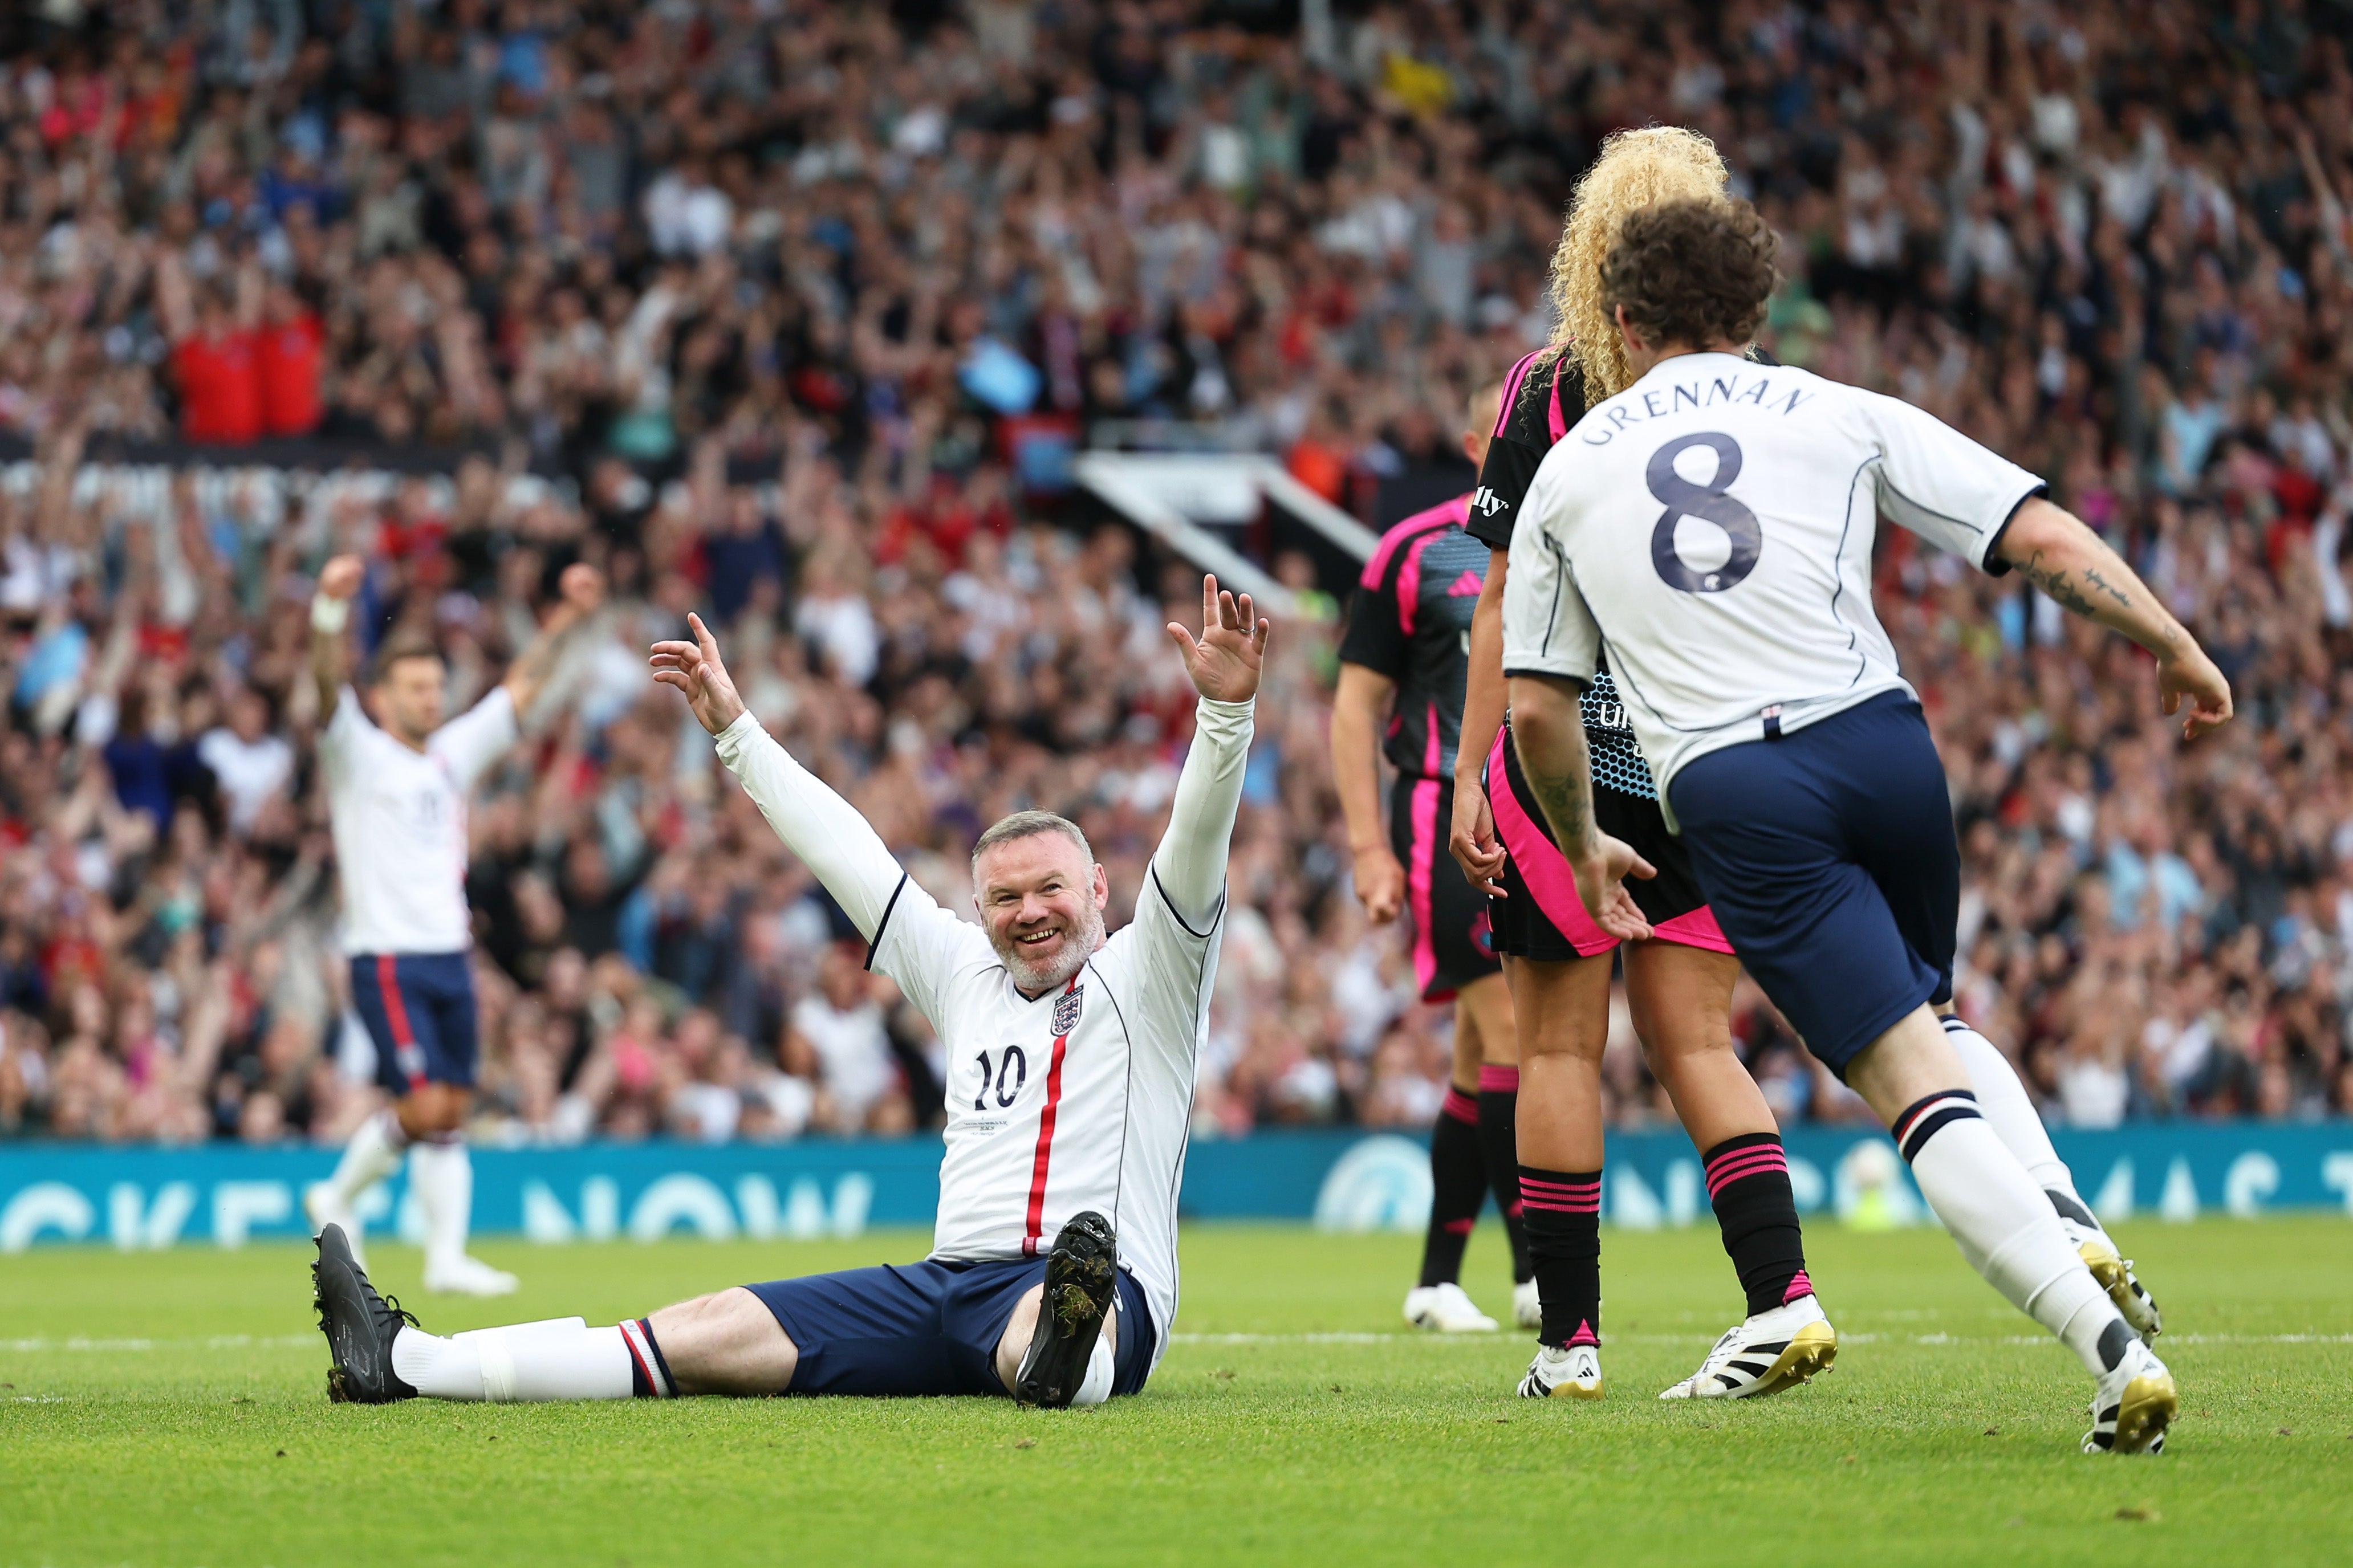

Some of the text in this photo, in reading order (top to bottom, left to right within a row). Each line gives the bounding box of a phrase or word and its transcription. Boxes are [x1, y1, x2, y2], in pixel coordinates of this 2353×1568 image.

[1582, 374, 1815, 446] GRENNAN
[1646, 431, 1762, 593] 8
[975, 1045, 1026, 1110] 10
